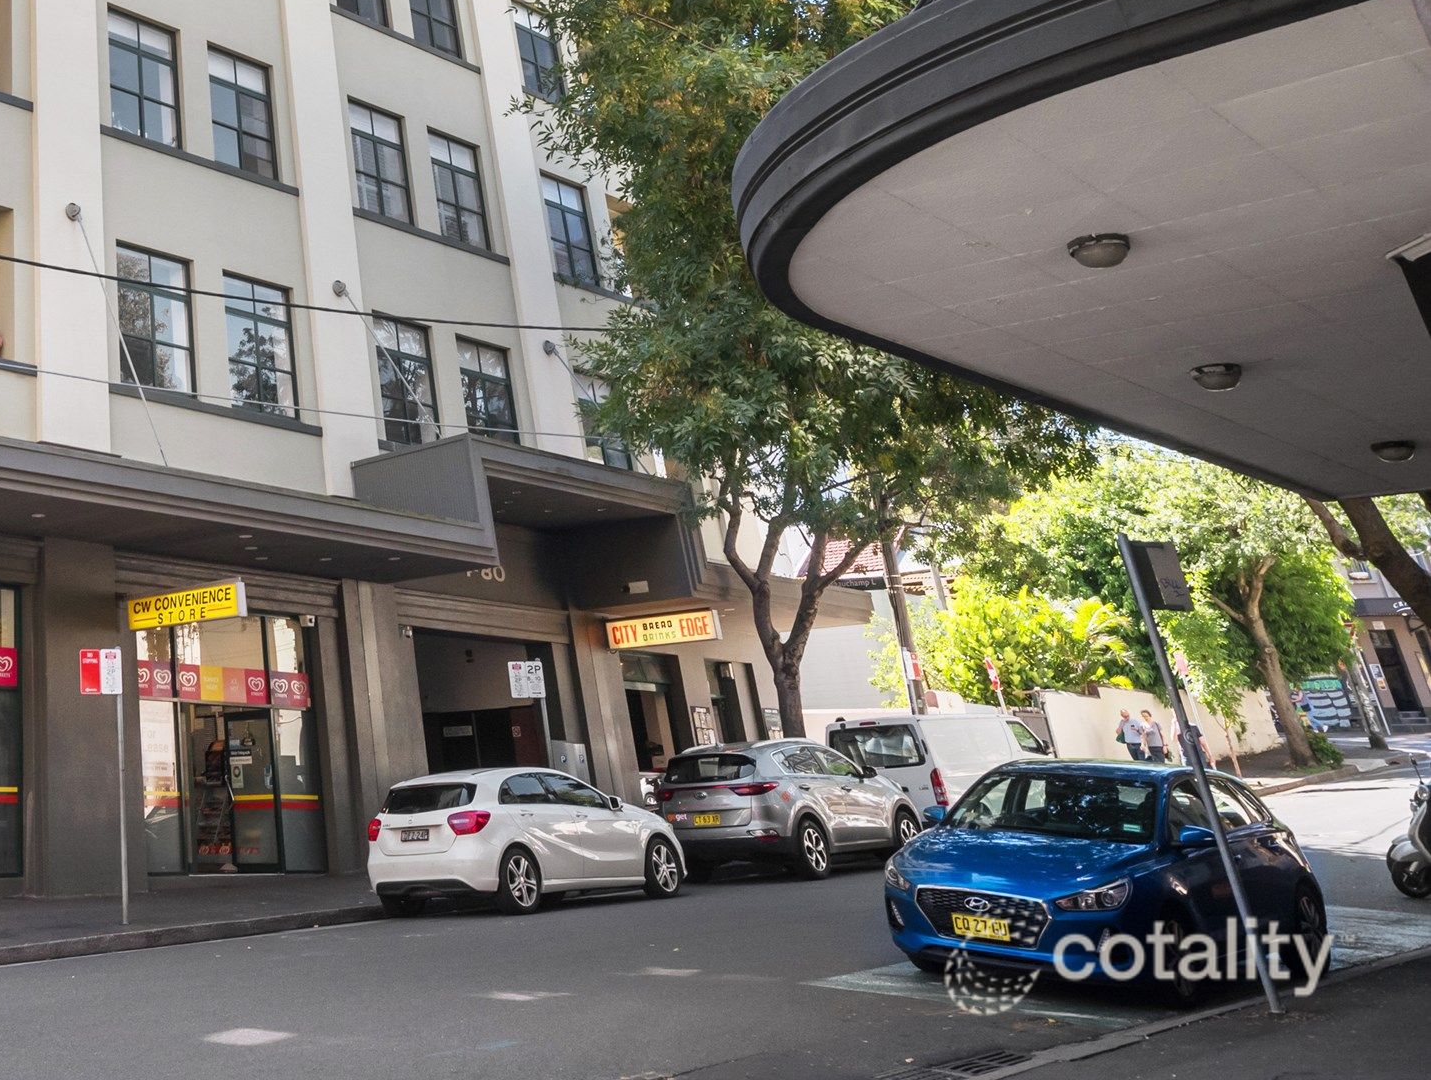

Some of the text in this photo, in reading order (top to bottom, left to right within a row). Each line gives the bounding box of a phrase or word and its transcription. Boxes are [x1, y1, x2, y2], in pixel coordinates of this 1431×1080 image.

[133, 587, 232, 614] CW CONVENIENCE
[157, 607, 206, 624] STORE
[642, 620, 673, 630] BREAD
[679, 616, 710, 637] EDGE
[612, 625, 637, 645] CITY
[526, 665, 541, 674] 2P
[972, 919, 987, 933] 27
